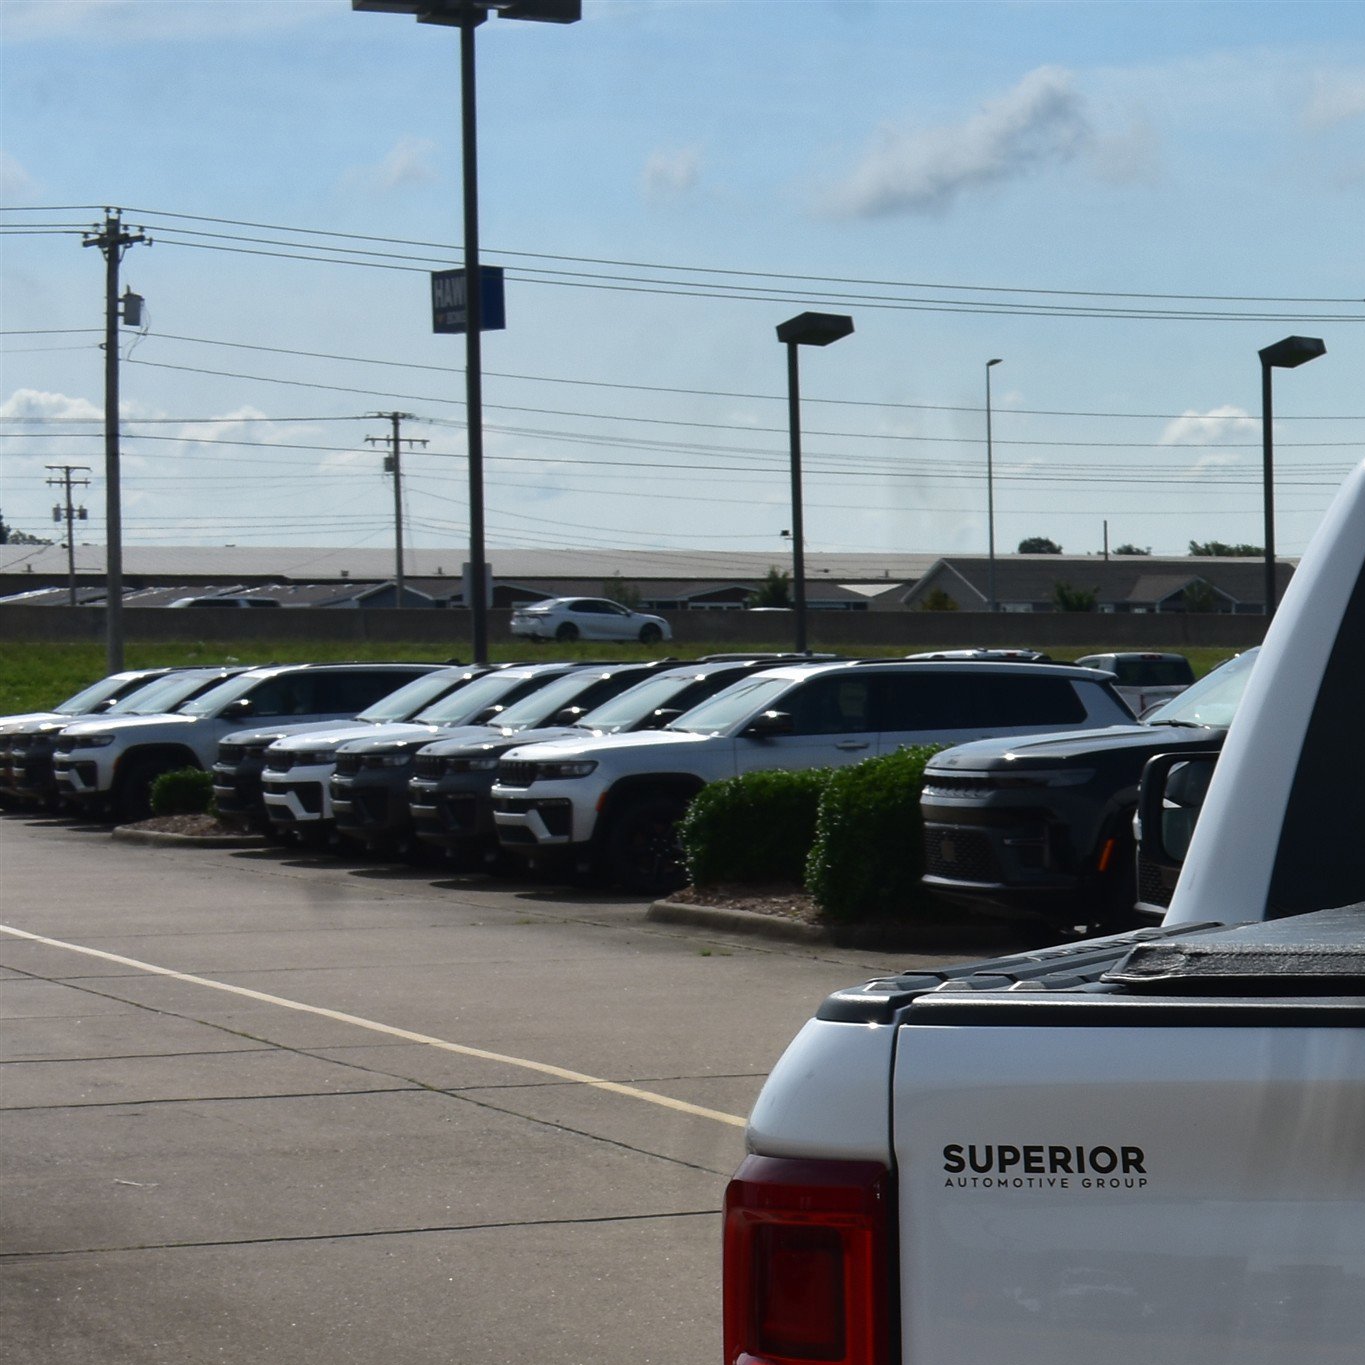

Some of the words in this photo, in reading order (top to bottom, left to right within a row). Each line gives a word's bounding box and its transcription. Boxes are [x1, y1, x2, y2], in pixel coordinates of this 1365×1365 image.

[942, 1144, 1148, 1175] SUPERIOR
[944, 1178, 1070, 1189] AUTOMOTIVE
[1081, 1178, 1149, 1189] GROUP
